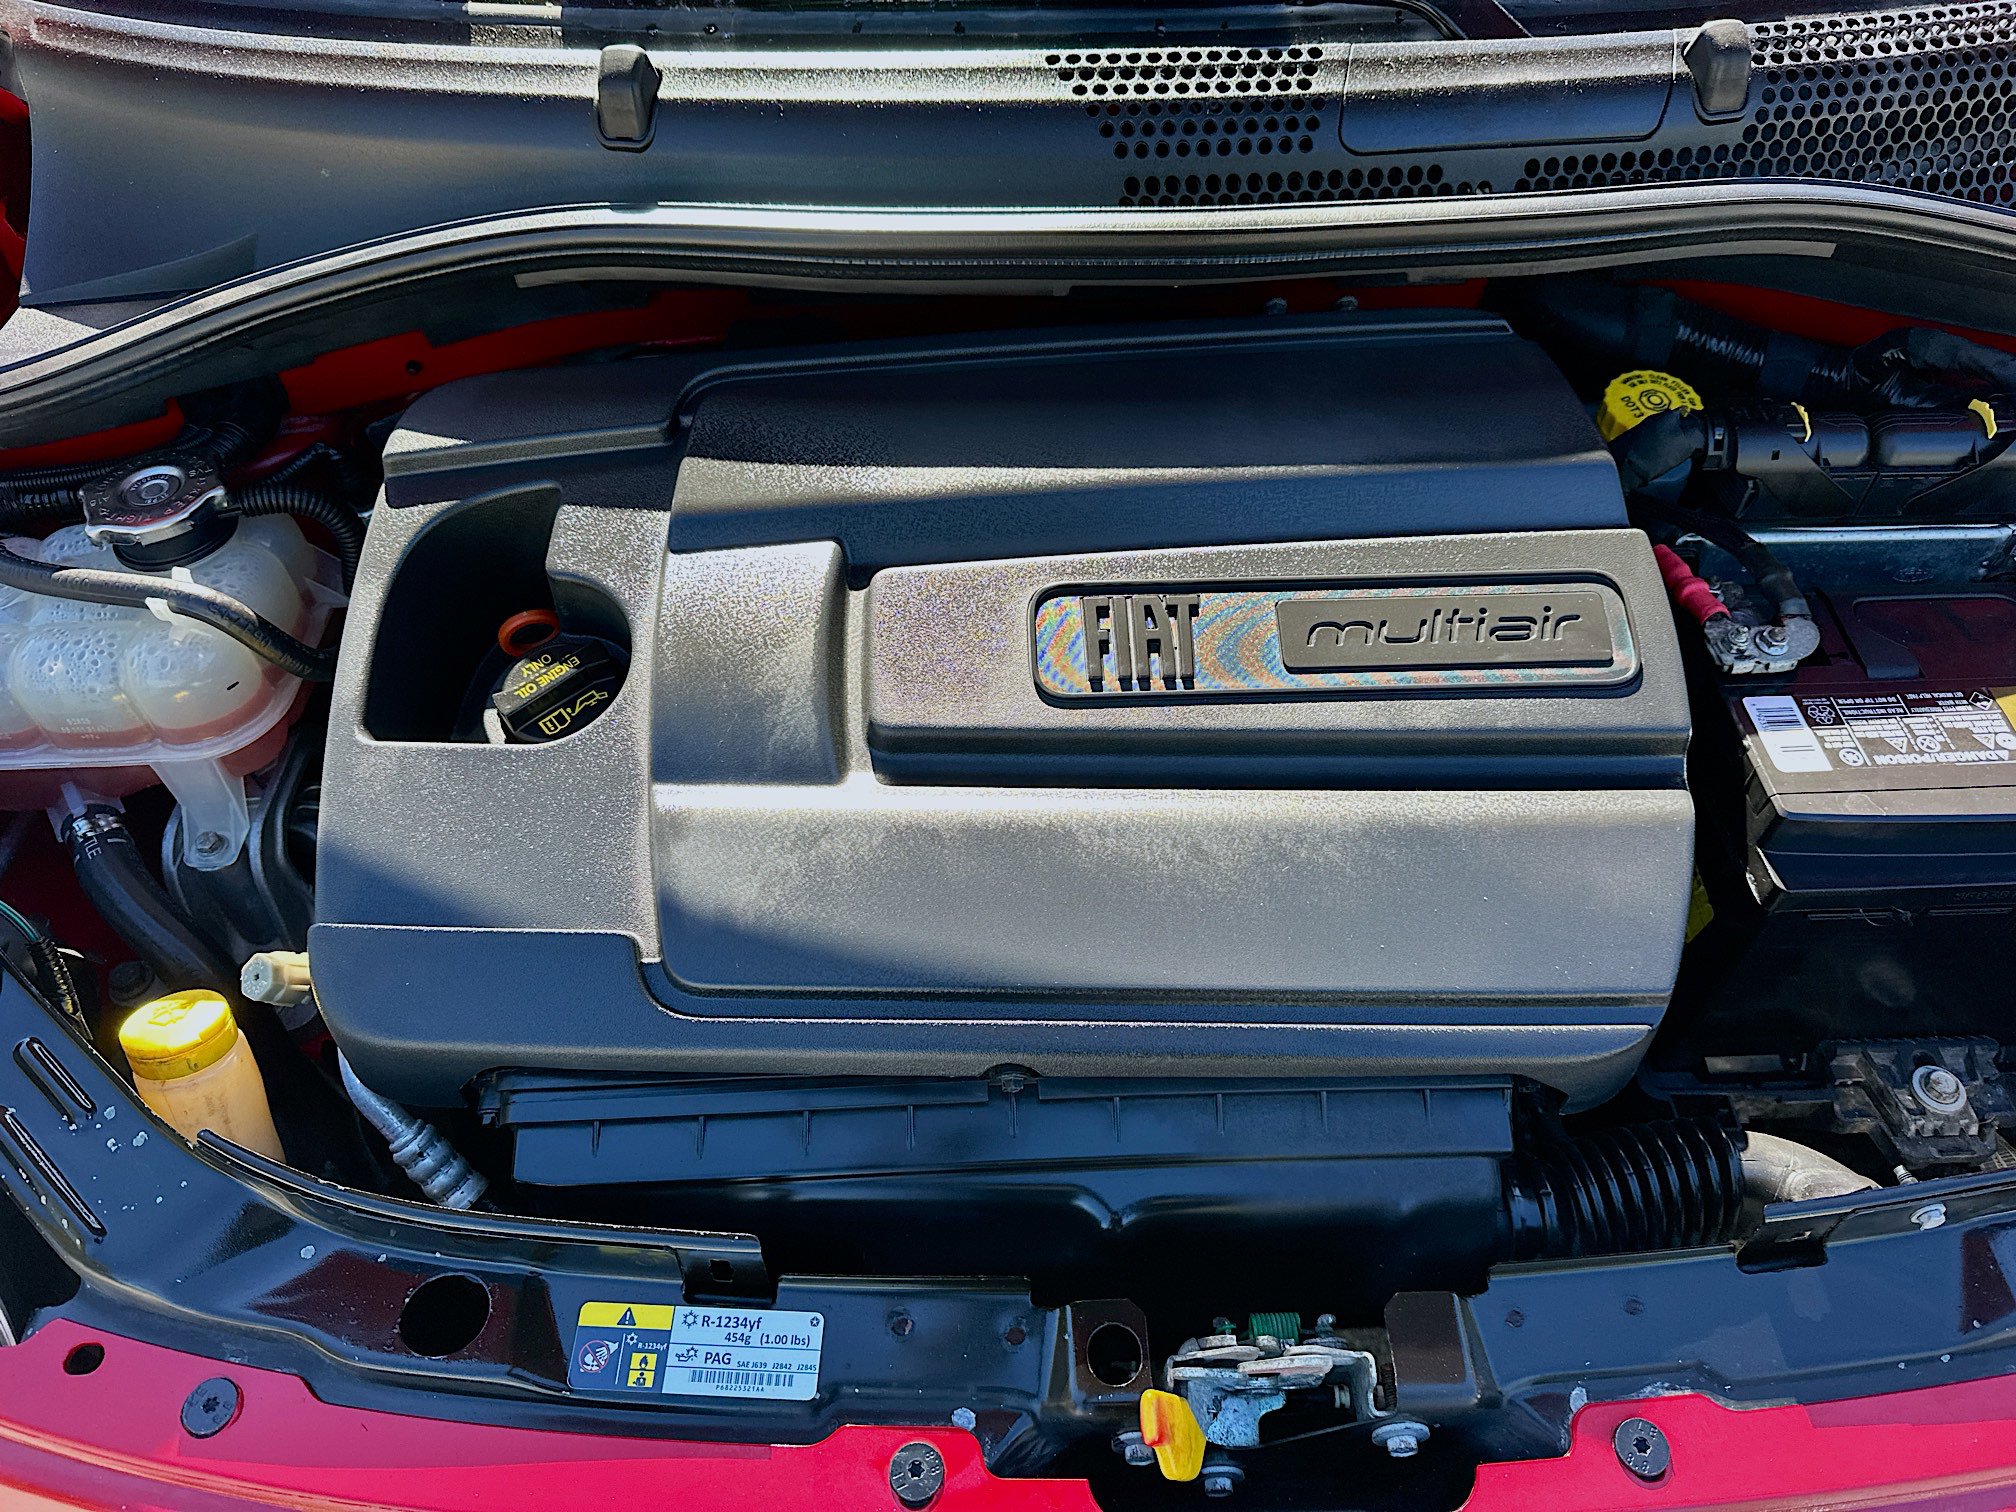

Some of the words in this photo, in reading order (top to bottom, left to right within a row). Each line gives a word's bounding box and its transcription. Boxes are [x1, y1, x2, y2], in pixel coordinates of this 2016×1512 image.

[1621, 395, 1645, 418] DOT3
[105, 513, 152, 523] TIGHT
[1306, 605, 1582, 647] multiair
[1081, 596, 1200, 691] FIAT
[521, 654, 552, 677] ONLY
[536, 656, 580, 688] ENGINE
[514, 683, 537, 699] OIL
[701, 1314, 763, 1332] R-1234yf
[637, 1342, 668, 1351] R-1234yf
[724, 1332, 752, 1345] 454g
[760, 1333, 789, 1346] (1.00
[790, 1334, 811, 1348] lbs)
[703, 1351, 733, 1365] PAG
[736, 1360, 750, 1368] SAE
[751, 1361, 768, 1369] J639
[772, 1362, 792, 1371] J2842
[796, 1363, 818, 1371] J2845
